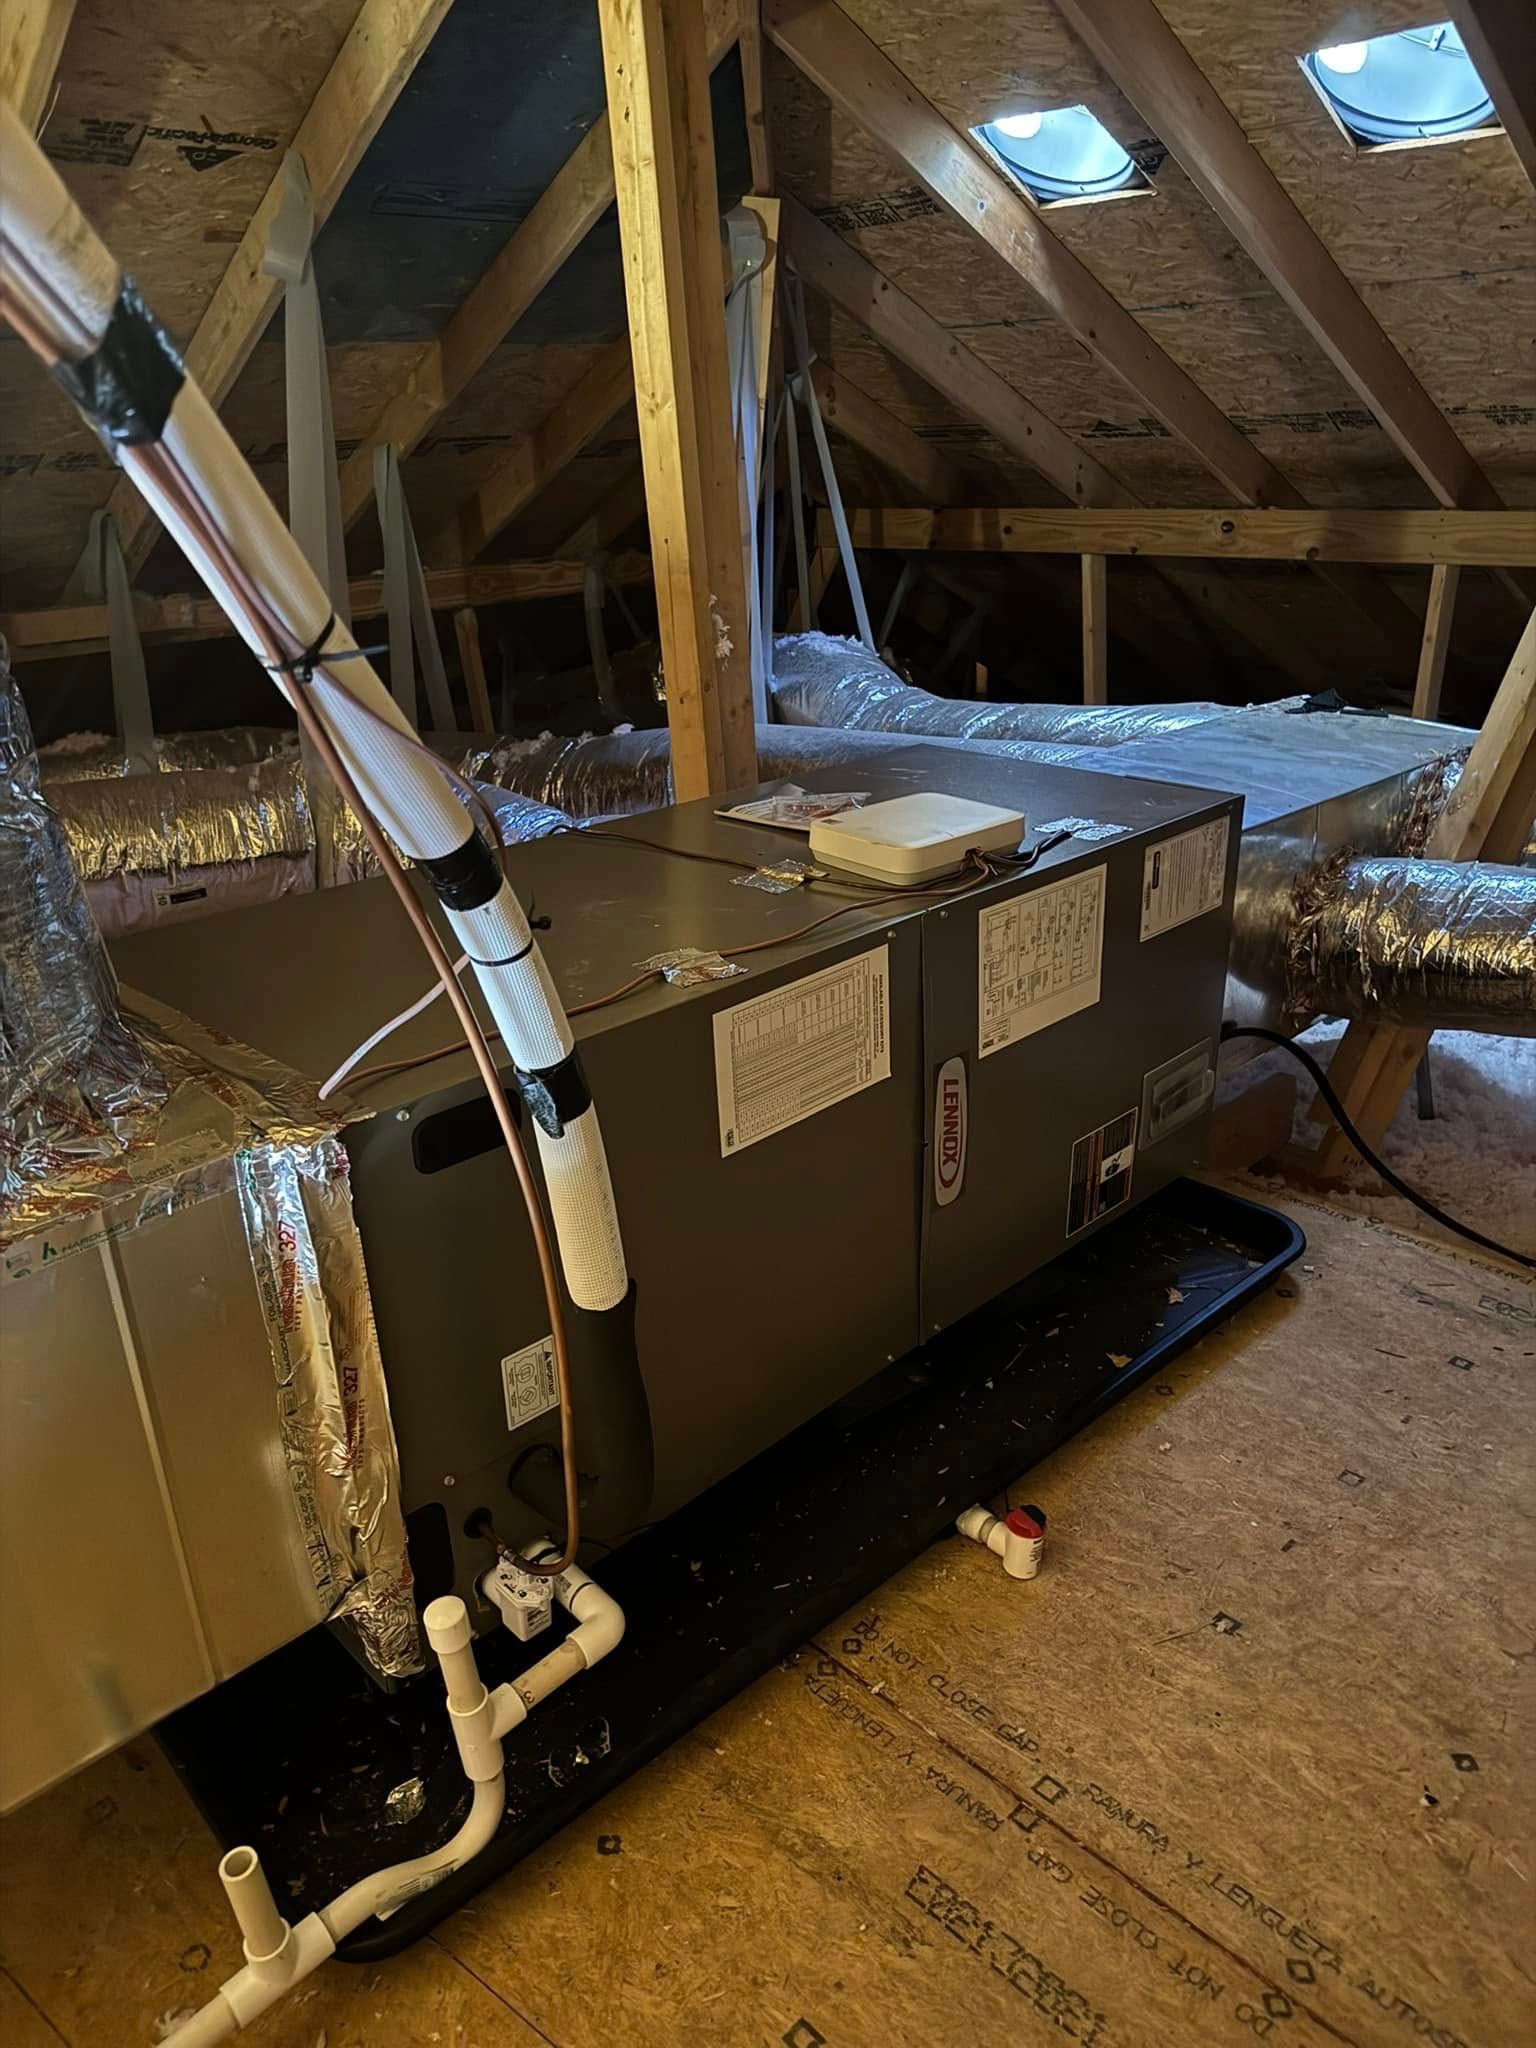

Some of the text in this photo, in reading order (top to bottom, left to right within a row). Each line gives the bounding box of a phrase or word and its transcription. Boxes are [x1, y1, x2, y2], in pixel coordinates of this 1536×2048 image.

[943, 1079, 960, 1165] LENNOX
[278, 1219, 297, 1252] 327
[343, 1367, 358, 1397] 327
[881, 1641, 924, 1671] NOT
[927, 1674, 995, 1722] CLOSE
[1081, 1782, 1169, 1853] RANURA
[1185, 1851, 1205, 1870] Y
[897, 1750, 916, 1766] Y
[925, 1765, 1005, 1833] RANURA
[1079, 1884, 1160, 1950] CLOSE
[1168, 1954, 1226, 2001] NOT
[1234, 2003, 1275, 2039] DO
